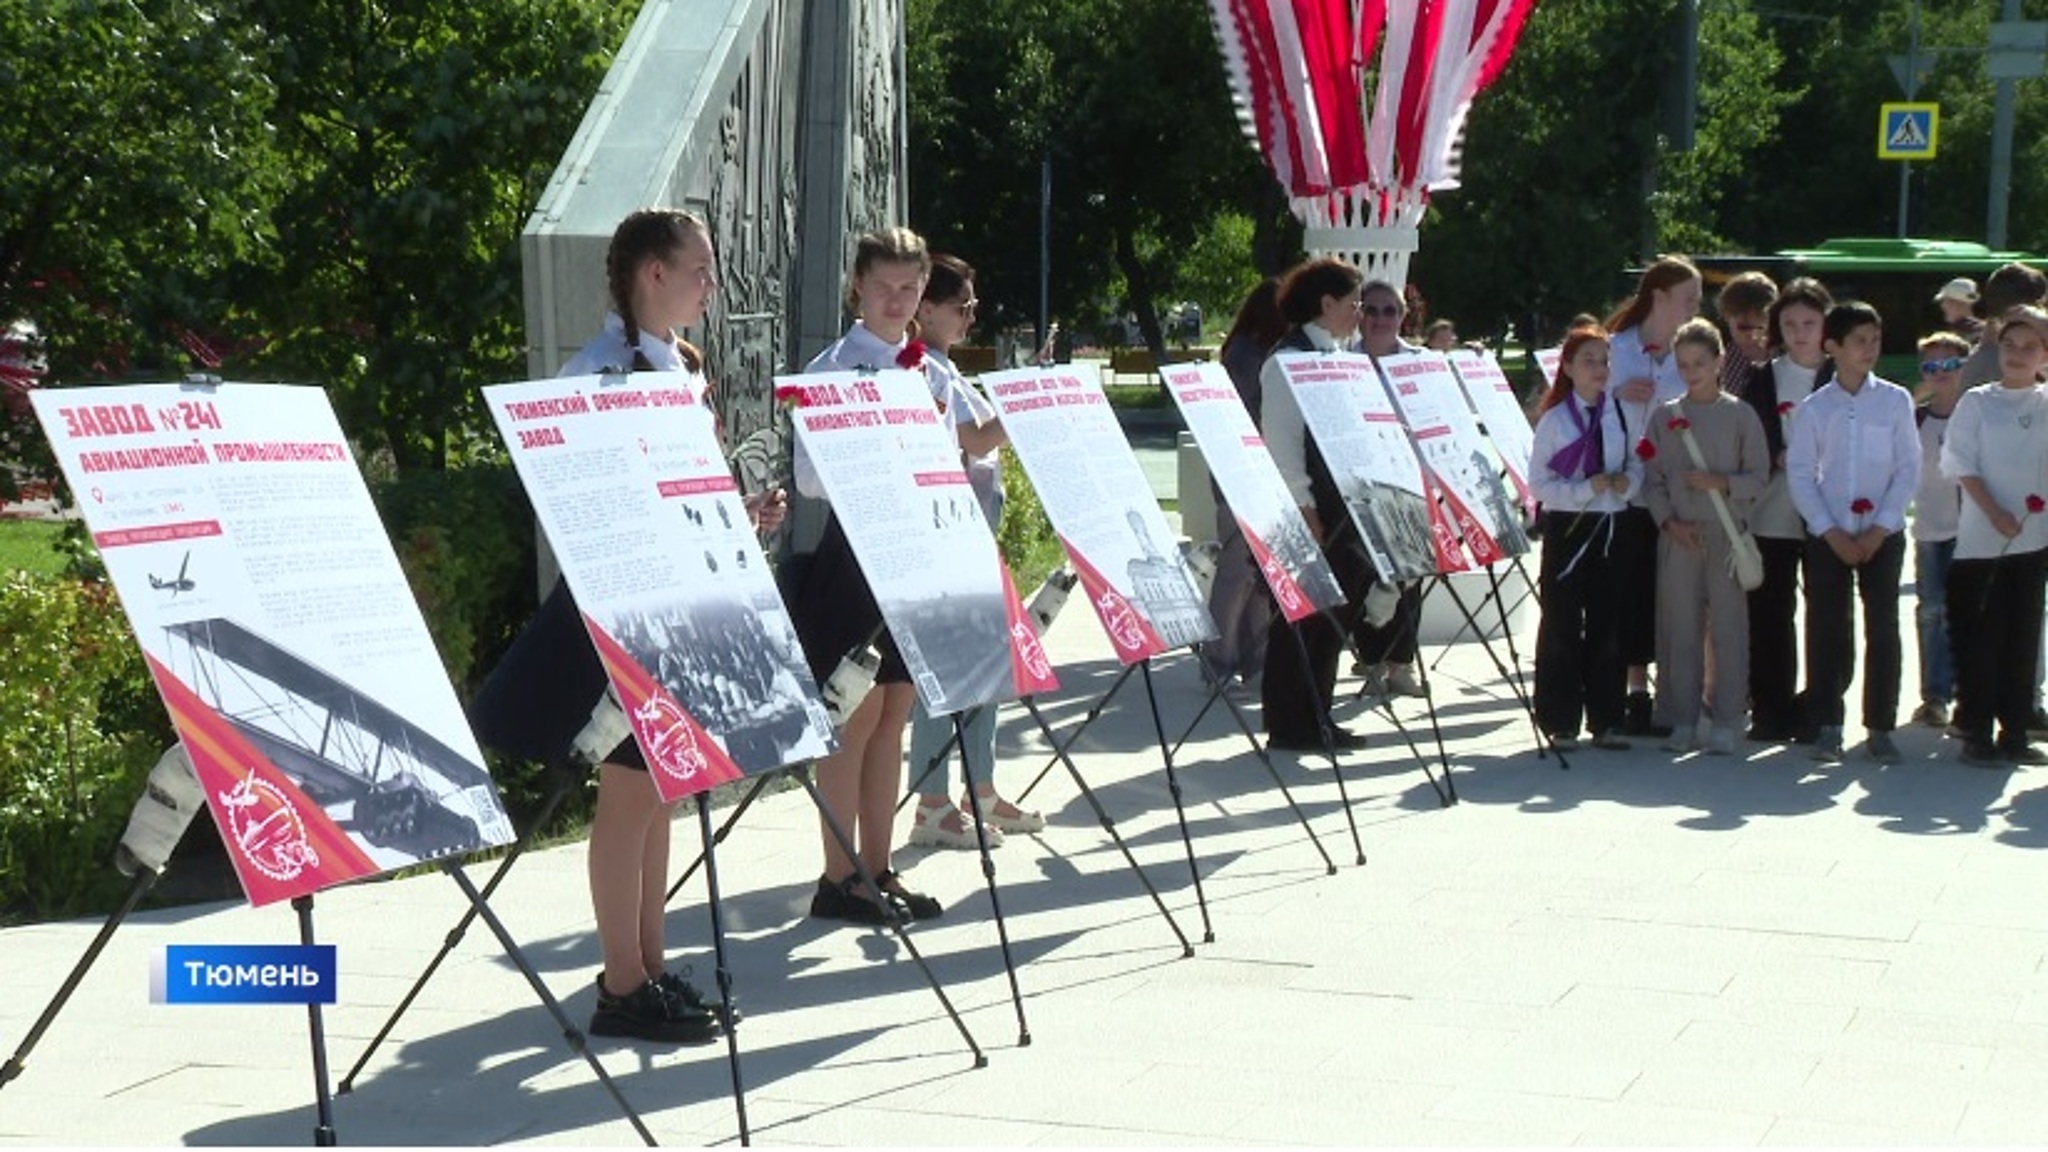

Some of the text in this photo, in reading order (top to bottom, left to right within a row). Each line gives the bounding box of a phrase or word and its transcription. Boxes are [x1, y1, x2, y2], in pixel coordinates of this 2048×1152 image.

[58, 401, 222, 438] ЗАВОД №241
[79, 438, 347, 474] АВИАЦИОННОЙ ПРОМЫШЛЕННОСТИ
[517, 426, 566, 450] ЗАВОД
